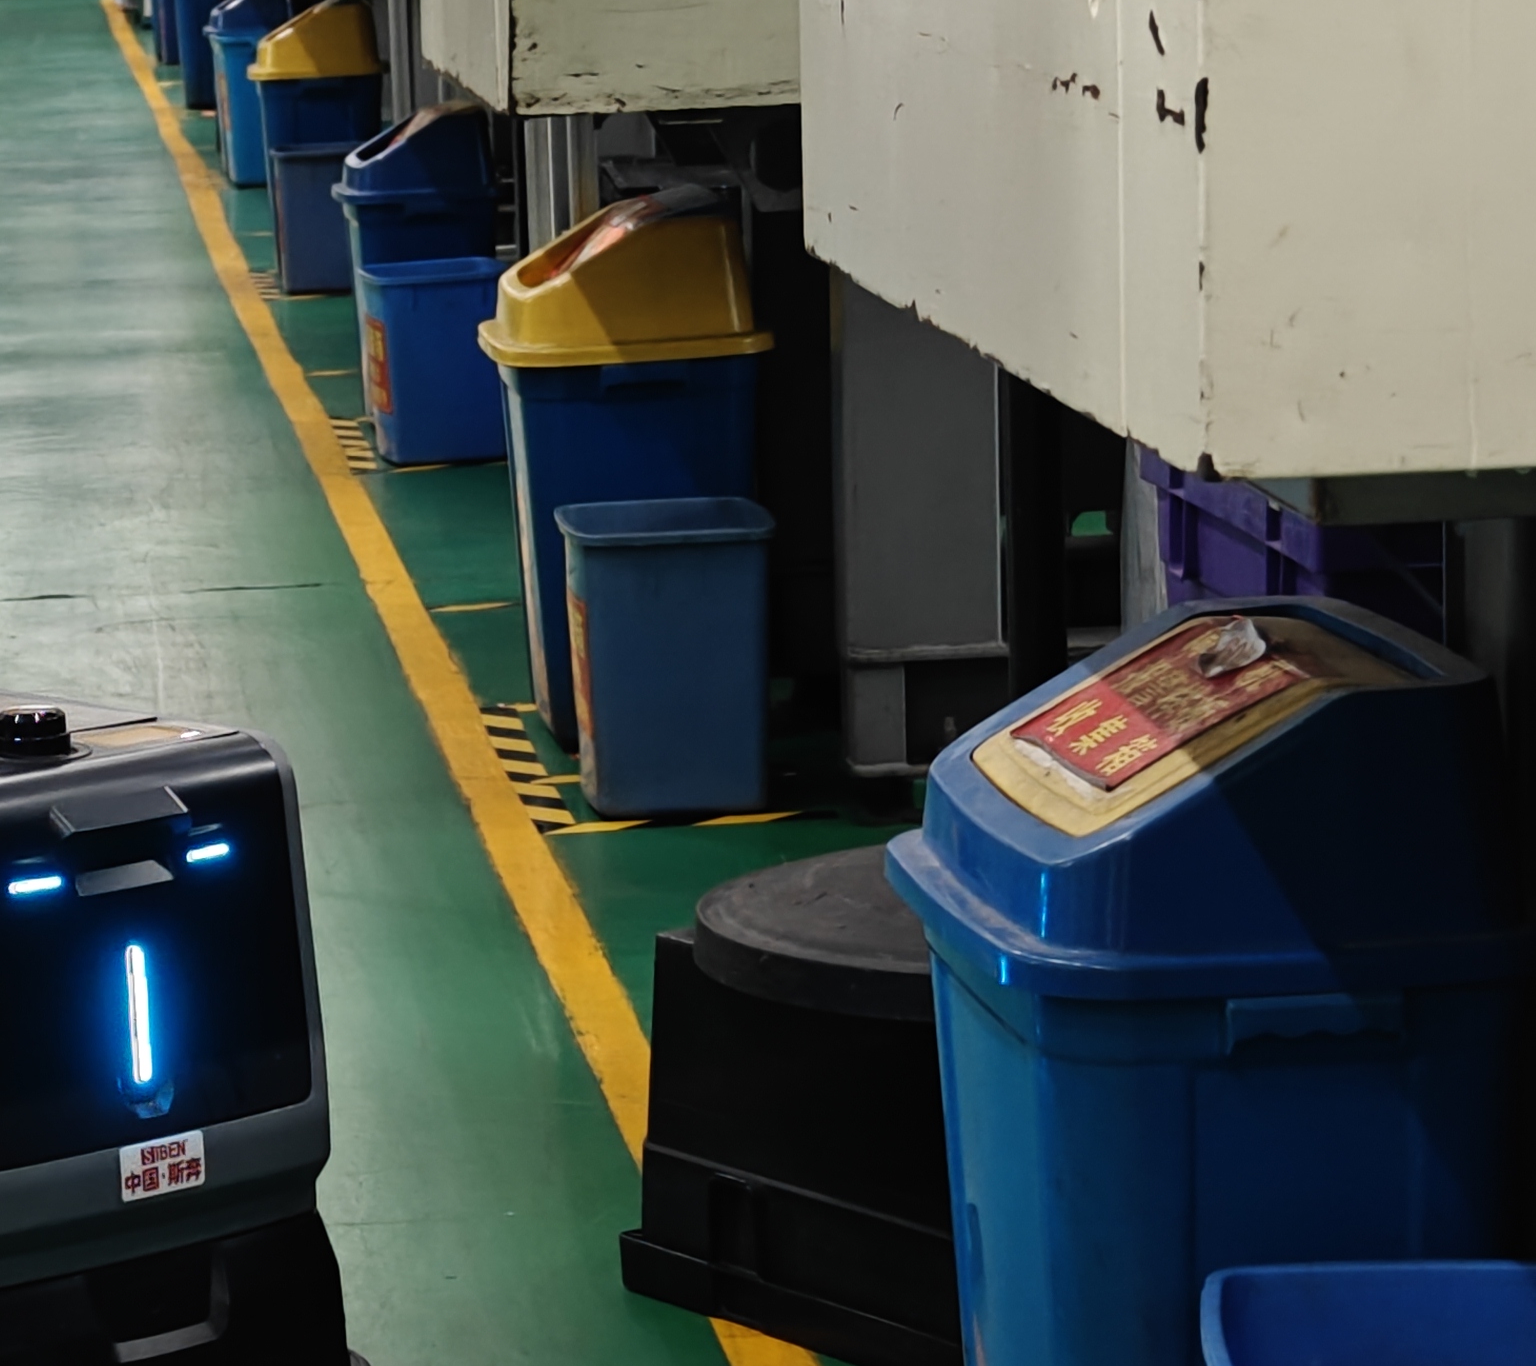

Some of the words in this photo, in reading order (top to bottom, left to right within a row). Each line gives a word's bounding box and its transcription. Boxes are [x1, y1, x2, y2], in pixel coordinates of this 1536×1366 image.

[1046, 698, 1159, 776] 收集箱
[141, 1140, 187, 1165] SIBEN
